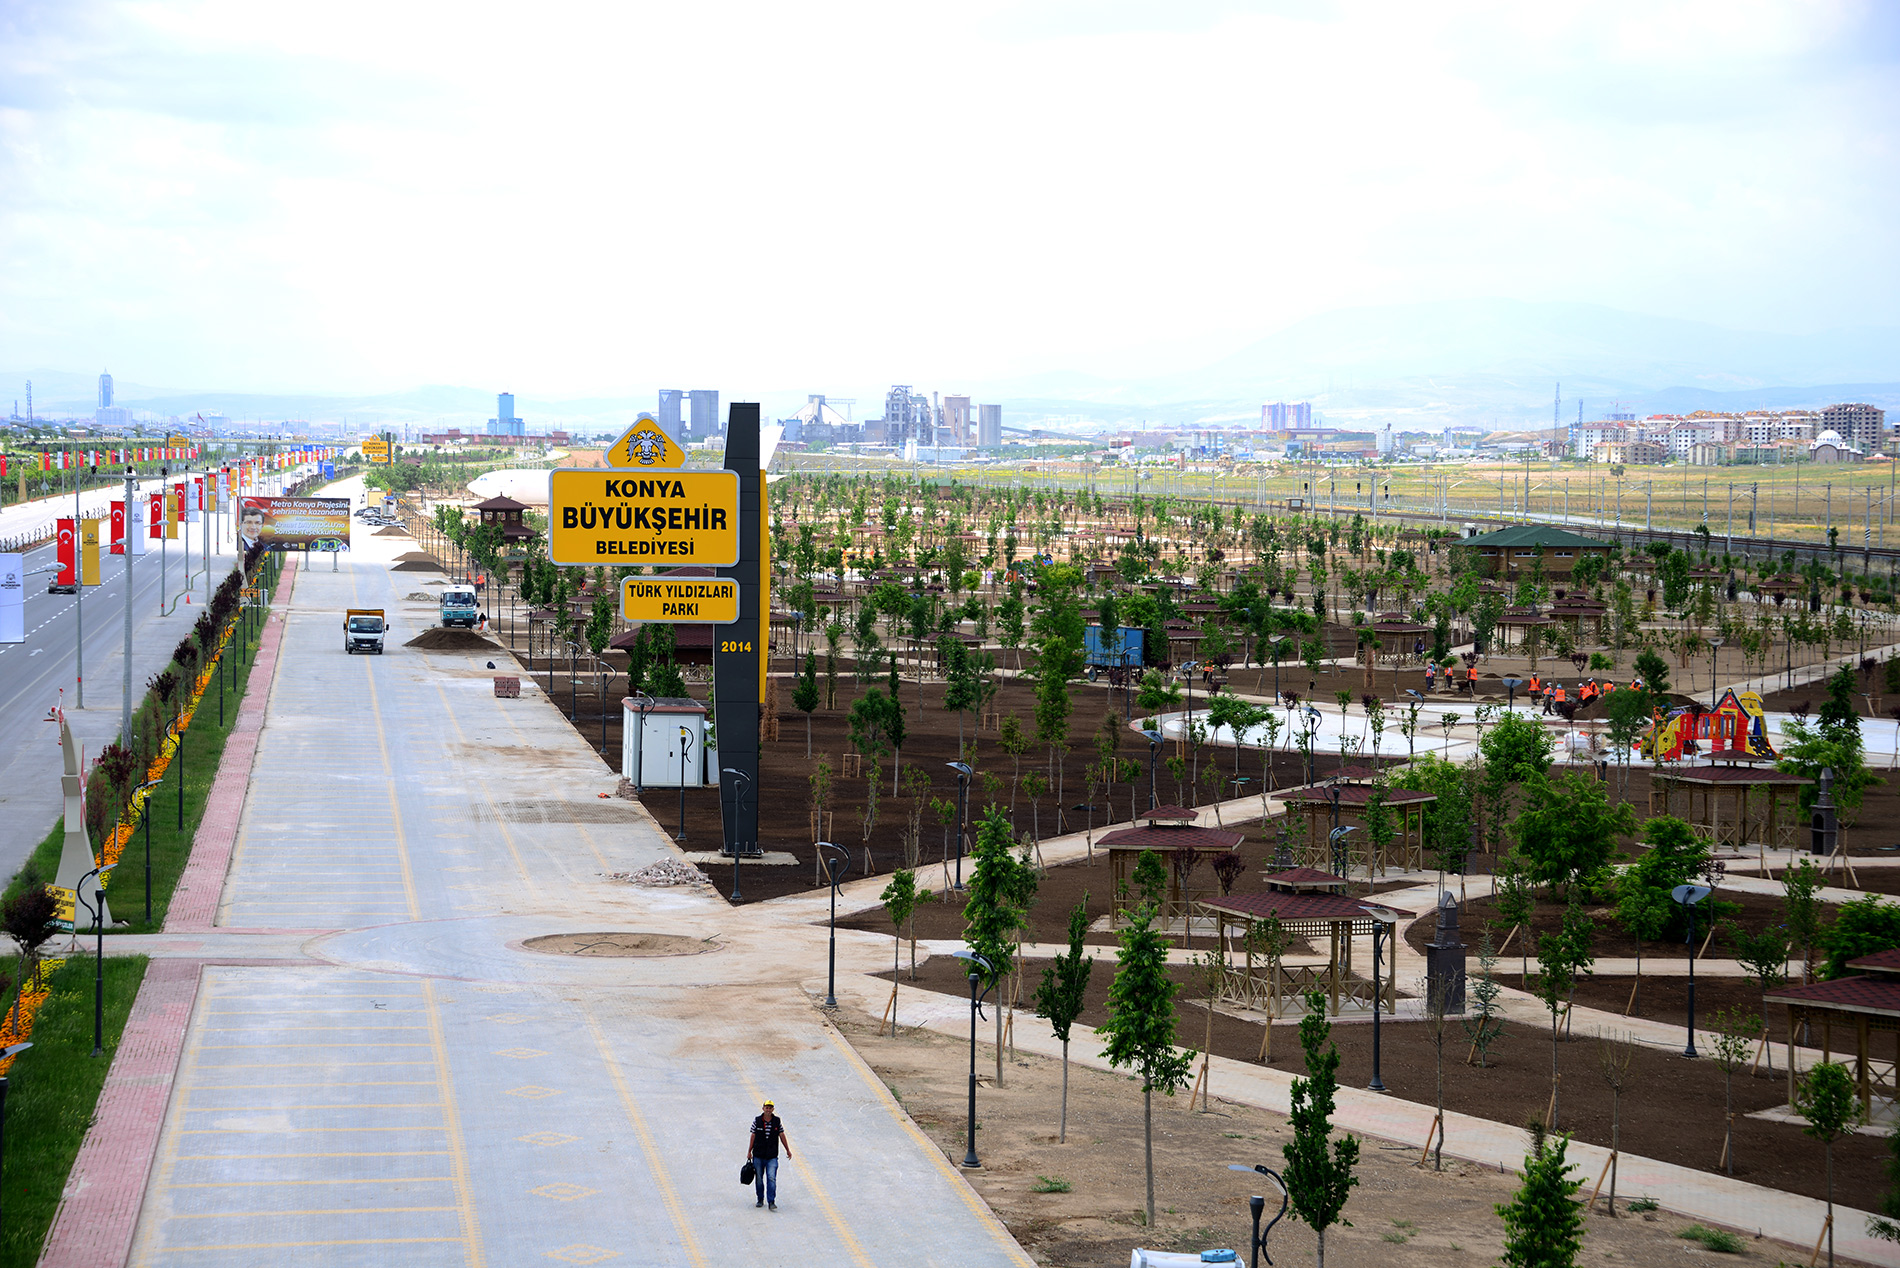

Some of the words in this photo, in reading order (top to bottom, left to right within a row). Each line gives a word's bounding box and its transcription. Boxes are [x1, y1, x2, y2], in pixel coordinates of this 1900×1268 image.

[605, 480, 686, 498] KONYA
[272, 508, 307, 516] şehrimize
[293, 501, 316, 509] Konya
[317, 501, 348, 509] Projesini
[563, 502, 727, 535] BÜYÜKŞEHİR
[596, 537, 694, 555] BELEDİYESİ
[628, 582, 662, 598] TÜRK
[666, 584, 733, 599] YILDIZLARI
[662, 602, 699, 616] PARKI
[721, 641, 752, 653] 2014
